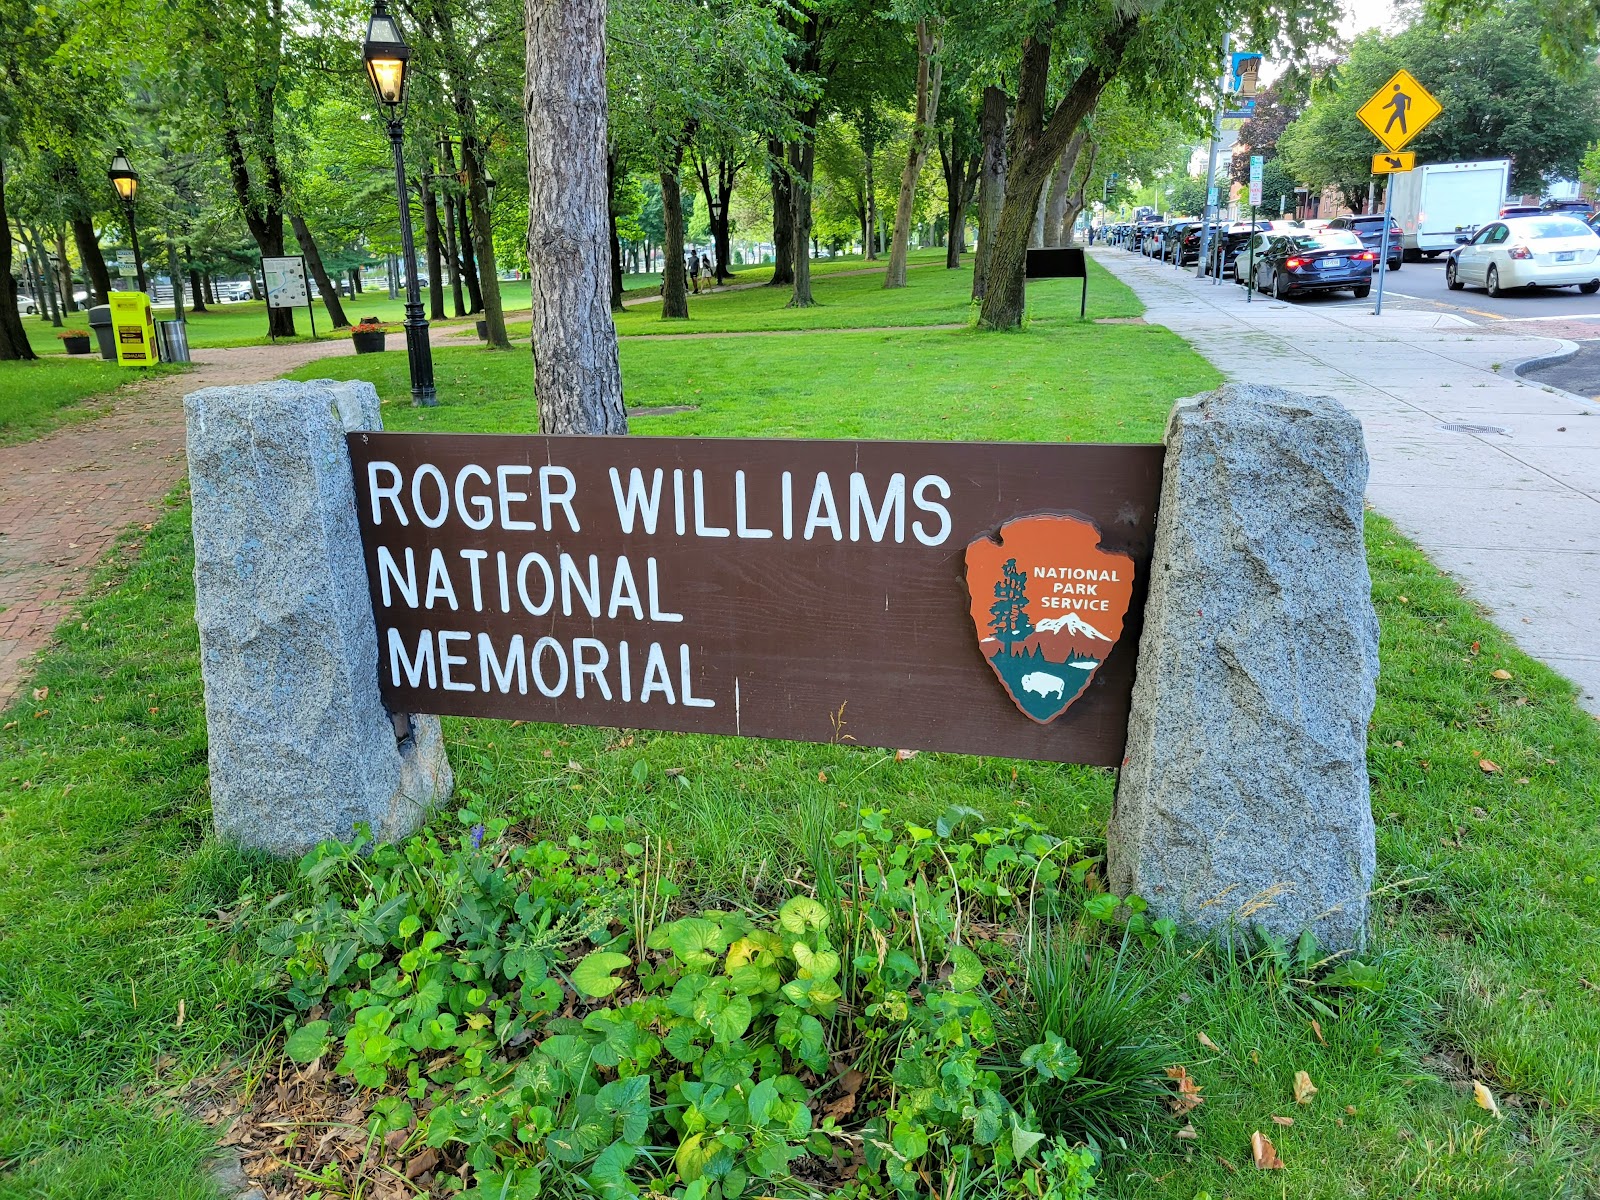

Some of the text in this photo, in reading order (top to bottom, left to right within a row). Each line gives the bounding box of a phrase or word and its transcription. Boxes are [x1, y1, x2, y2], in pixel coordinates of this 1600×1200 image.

[367, 461, 952, 547] ROGER WILLIAMS
[377, 546, 684, 623] NATIONAL
[1033, 566, 1121, 582] NATIONAL
[1053, 583, 1099, 596] PARK
[1041, 596, 1110, 612] SERVICE
[387, 627, 716, 707] MEMORIAL
